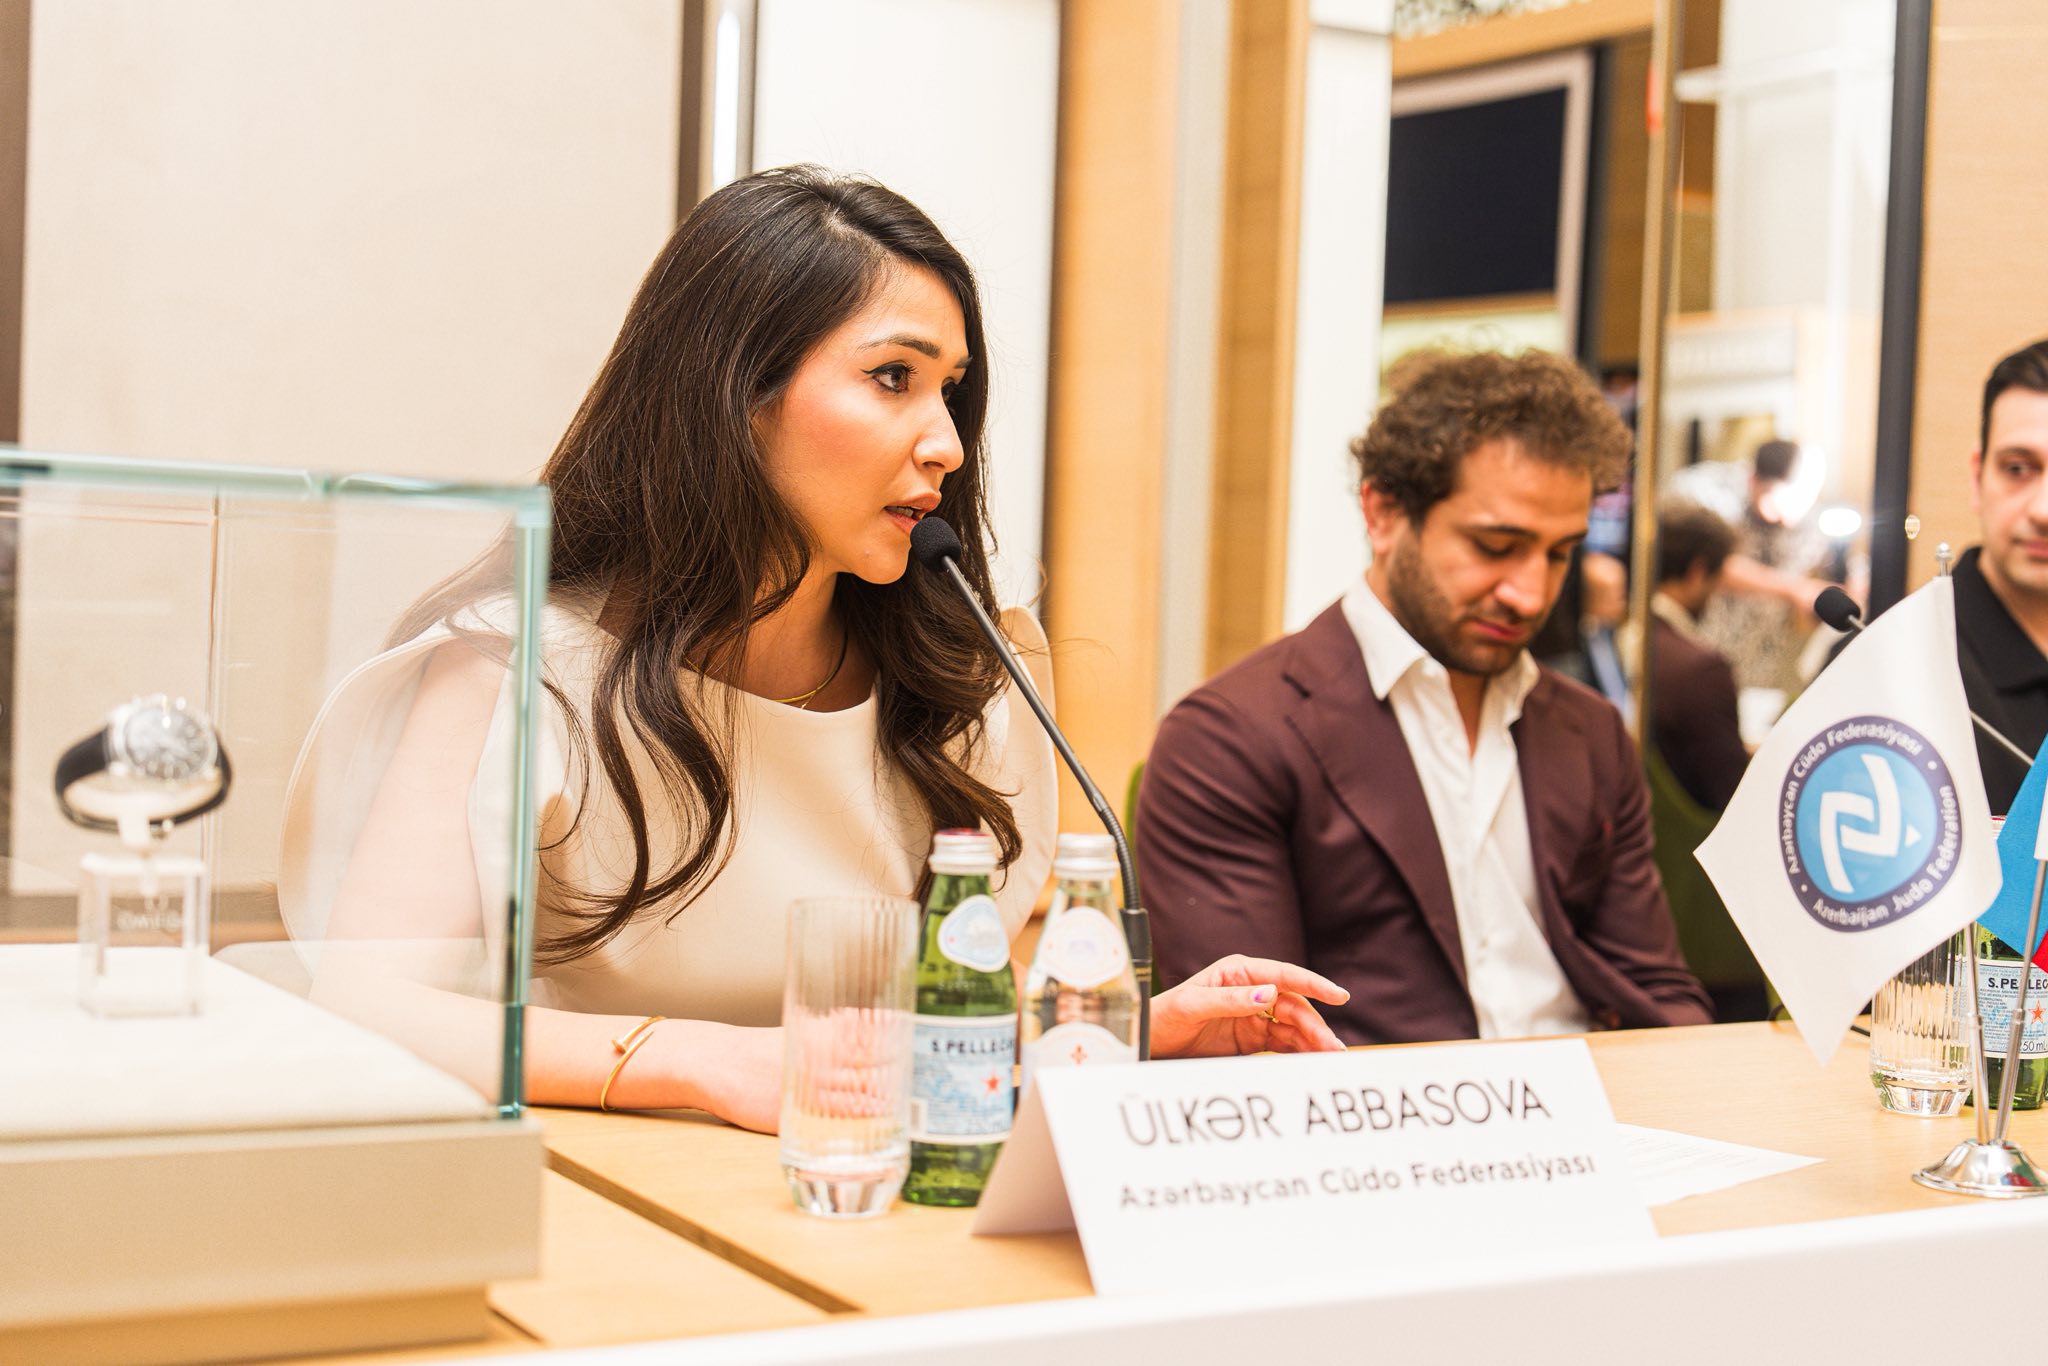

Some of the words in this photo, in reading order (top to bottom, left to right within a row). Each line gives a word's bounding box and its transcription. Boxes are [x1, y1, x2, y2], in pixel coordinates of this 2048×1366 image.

[1793, 742, 1827, 778] Cüdo
[1813, 898, 1889, 928] Azerbaijan
[1892, 878, 1934, 912] Judo
[1927, 785, 1959, 881] Federation
[1988, 977, 2048, 990] S.PELEG
[1119, 1091, 1281, 1147] ÜLKƏR
[1305, 1079, 1552, 1135] ABBASOVA
[1119, 1177, 1310, 1208] Azərbaycan
[1319, 1164, 1401, 1194] Cüdo
[1410, 1152, 1596, 1186] Federasiyası
